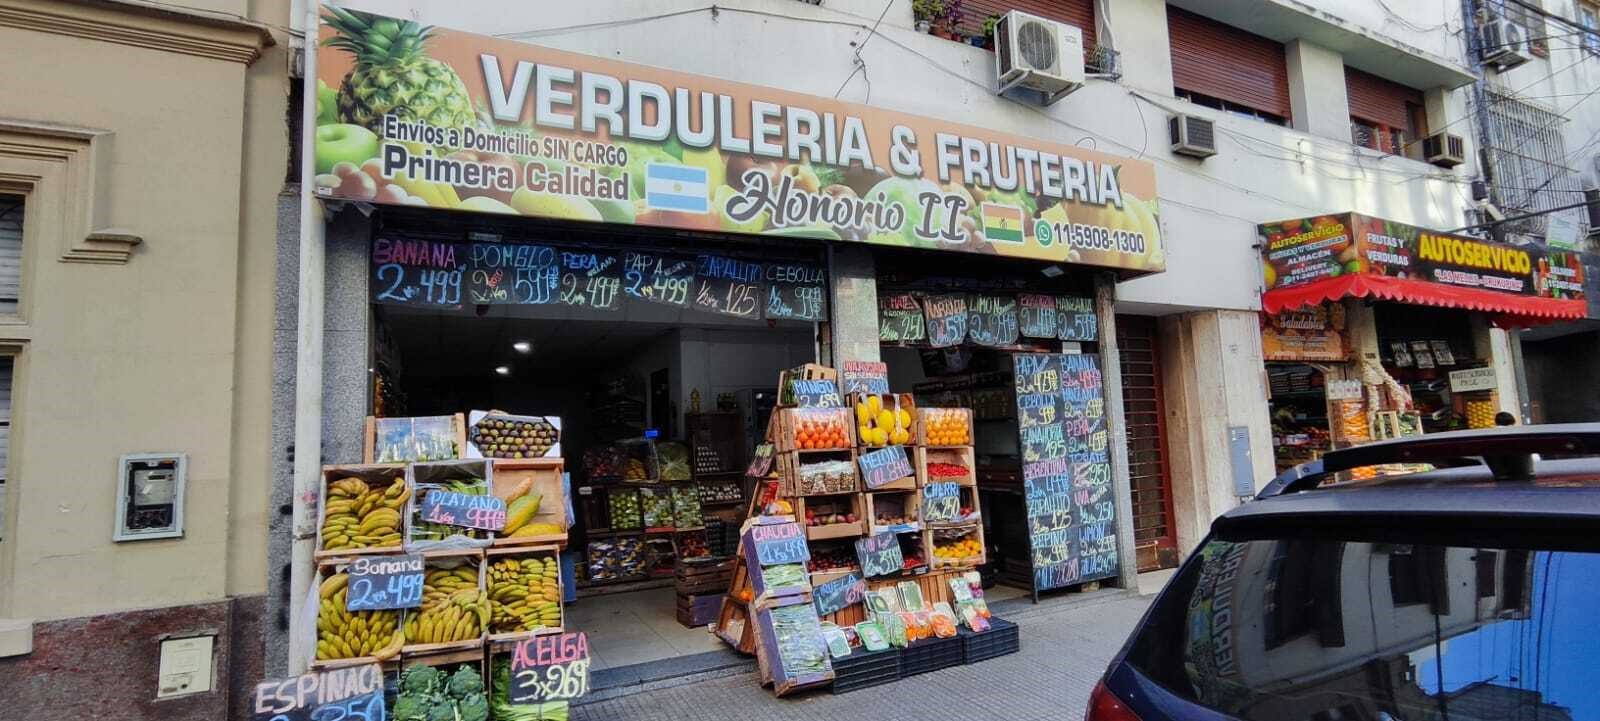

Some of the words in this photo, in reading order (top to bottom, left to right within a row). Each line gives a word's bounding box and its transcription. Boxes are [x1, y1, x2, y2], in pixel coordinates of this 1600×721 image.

[383, 115, 445, 147] Envios
[448, 131, 459, 147] a
[463, 126, 539, 157] Domicilio
[543, 137, 569, 161] SIN
[573, 142, 628, 168] CARGO
[480, 53, 876, 170] VERDULERIA
[889, 125, 923, 178] &
[936, 131, 1125, 209] FRUTERIA
[383, 144, 516, 191] Primera
[525, 161, 629, 201] Calidad
[725, 169, 905, 231] Honorio
[914, 190, 968, 242] II
[1270, 223, 1345, 250] AUTOSERVICIO
[1367, 233, 1398, 248] FRUTAS
[1398, 238, 1405, 249] Y
[373, 239, 457, 269] BANANA
[1367, 249, 1409, 266] VERDURAS
[1419, 233, 1530, 275] AUTOSERVICIO
[377, 264, 408, 303] 2
[420, 268, 462, 304] 499
[472, 270, 490, 303] 2
[561, 272, 577, 305] 2
[624, 271, 642, 297] 2
[653, 276, 688, 304] 499
[766, 264, 824, 284] CEBOLLA
[721, 283, 755, 316] 125
[902, 313, 924, 340] 250
[792, 380, 834, 394] MANGO
[818, 392, 841, 408] 699
[431, 491, 501, 512] PLATANO
[753, 526, 800, 541] CHAUCHA
[351, 578, 374, 607] 2
[387, 573, 425, 605] 499
[511, 631, 589, 671] ACELGA
[255, 663, 384, 714] ESPINACA
